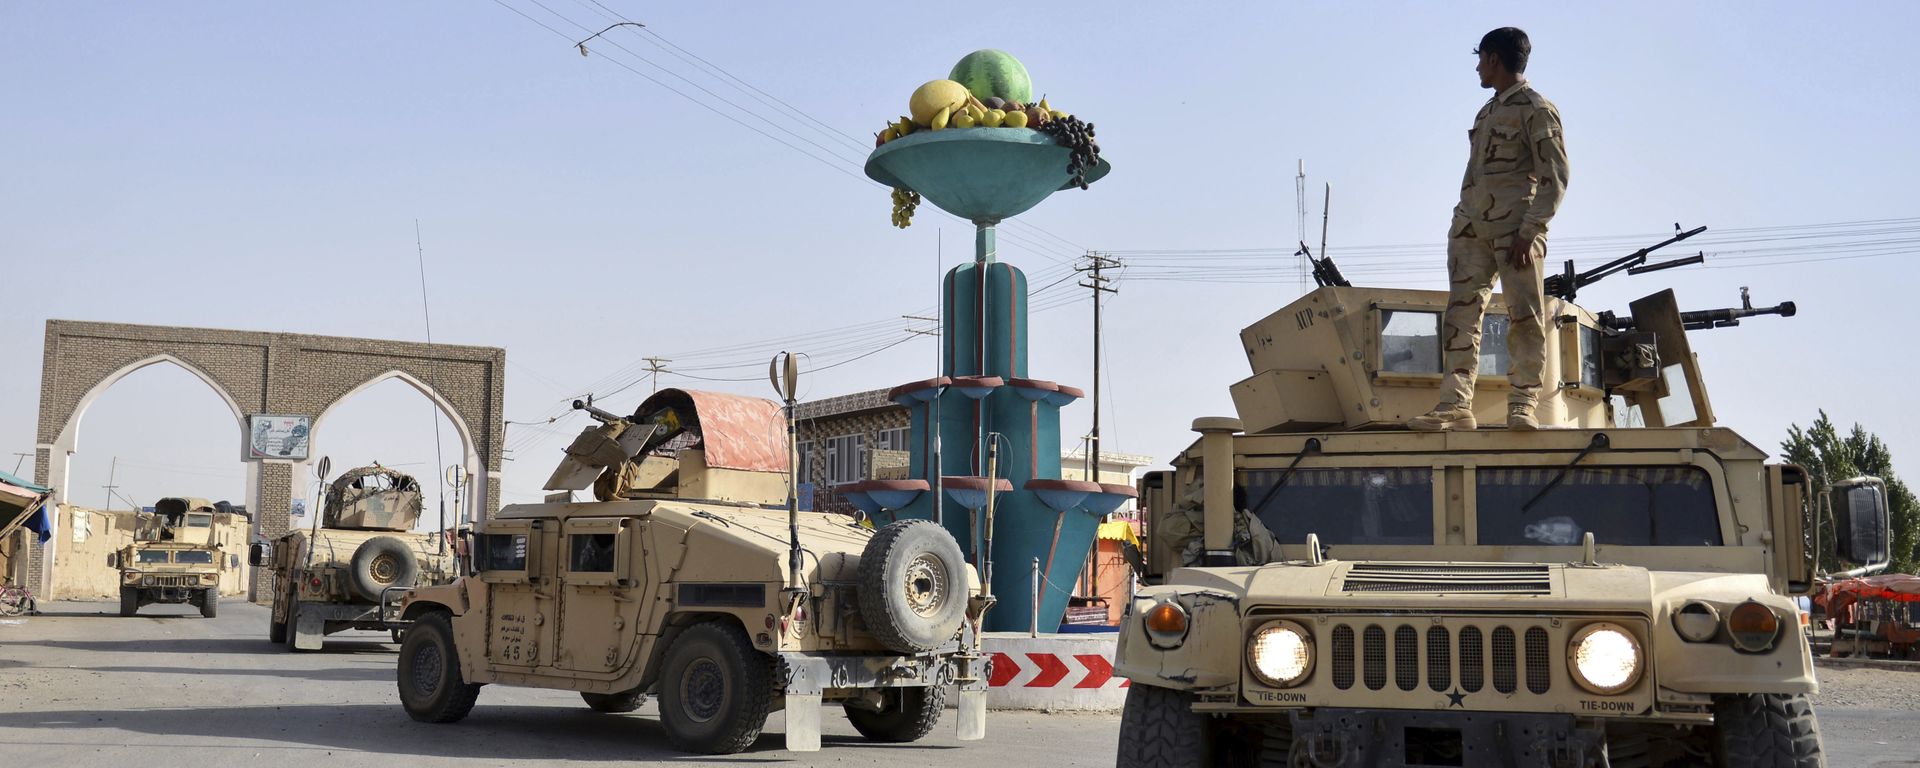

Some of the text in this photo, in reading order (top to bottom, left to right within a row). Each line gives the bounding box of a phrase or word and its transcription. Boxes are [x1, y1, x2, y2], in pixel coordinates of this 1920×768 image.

[1295, 307, 1314, 331] AUP
[503, 645, 520, 660] 45
[1259, 692, 1306, 702] TIE-DOWN
[1579, 700, 1634, 711] TIE-DOWN
